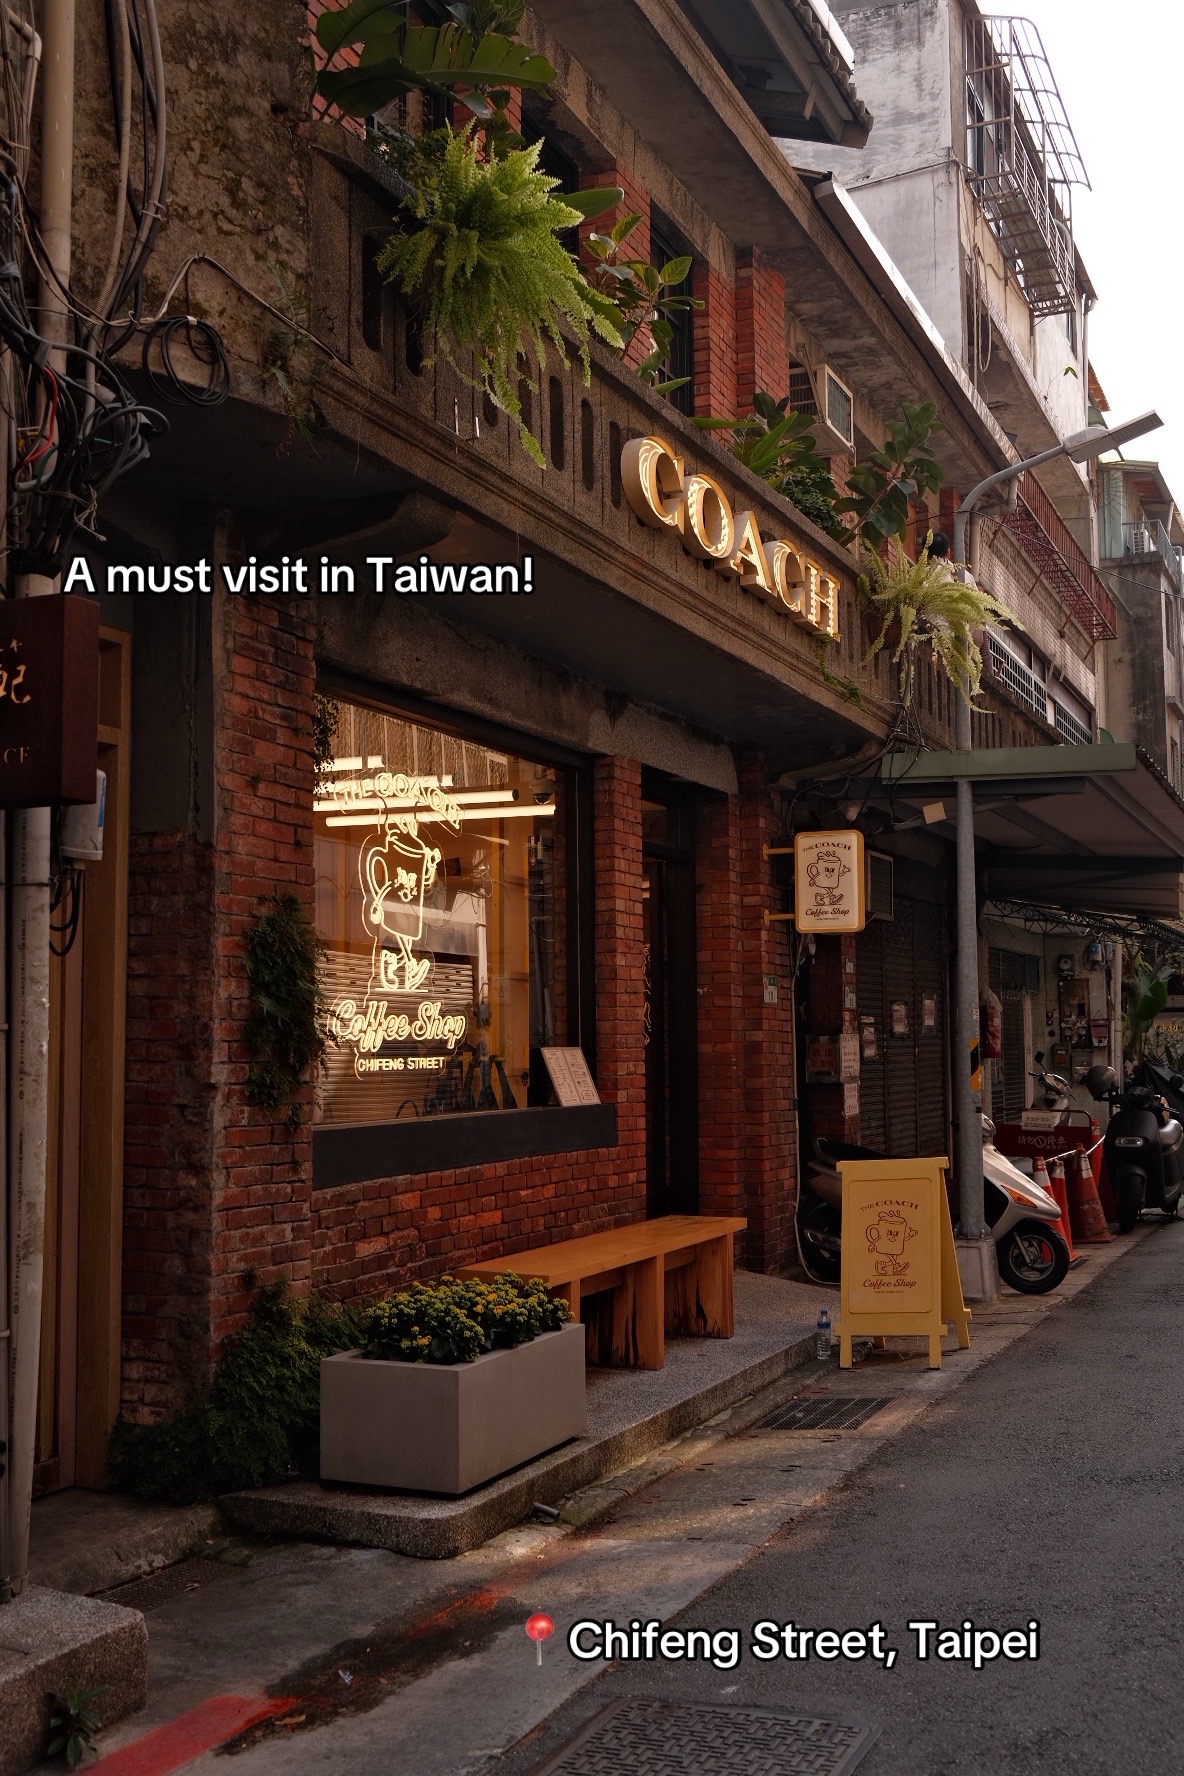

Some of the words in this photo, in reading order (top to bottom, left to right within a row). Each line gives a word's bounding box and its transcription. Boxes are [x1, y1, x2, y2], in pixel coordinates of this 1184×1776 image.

[621, 436, 842, 643] COACH
[339, 778, 373, 806] THE
[374, 772, 463, 830] COACH
[802, 844, 814, 852] THE
[814, 841, 851, 851] COACH
[805, 908, 829, 917] Coffee
[830, 907, 850, 916] Shop
[333, 999, 412, 1053] Coffee
[411, 1001, 466, 1049] Shop
[357, 1057, 405, 1072] CHIFENG
[407, 1056, 445, 1070] STREET
[860, 1203, 874, 1211] THE
[875, 1199, 919, 1210] COACH
[863, 1278, 892, 1290] Coffee
[893, 1278, 917, 1289] Shop
